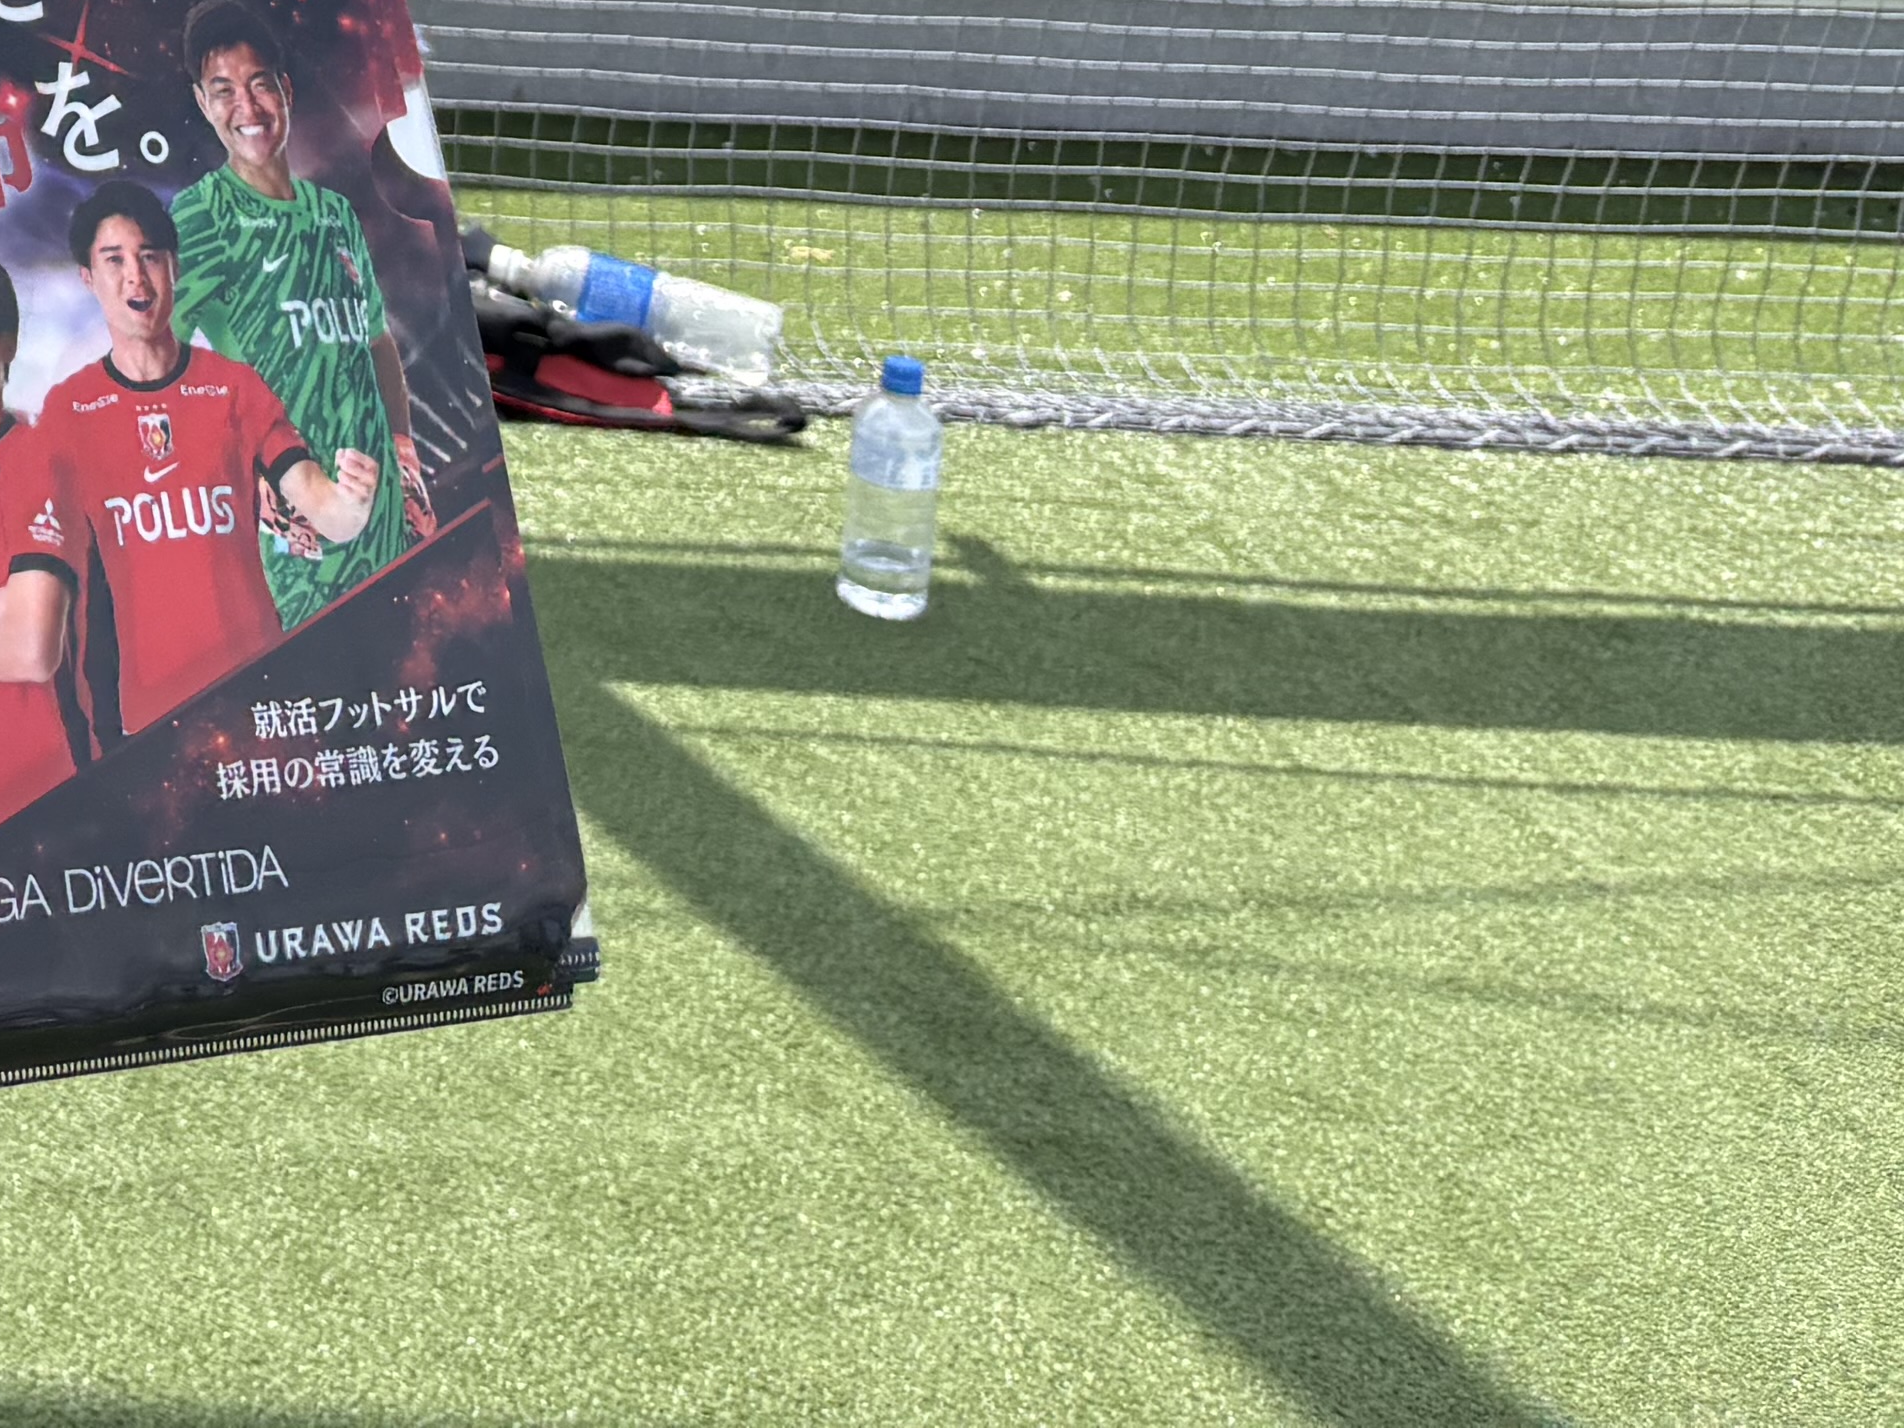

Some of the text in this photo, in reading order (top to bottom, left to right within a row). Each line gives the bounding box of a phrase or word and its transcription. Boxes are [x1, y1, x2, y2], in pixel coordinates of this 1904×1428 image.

[103, 485, 236, 547] POLUS
[250, 680, 487, 740] 就活フットサルで
[215, 734, 500, 801] 採用の常識を変える
[255, 902, 504, 963] URAWA REDS
[472, 969, 525, 995] REDS
